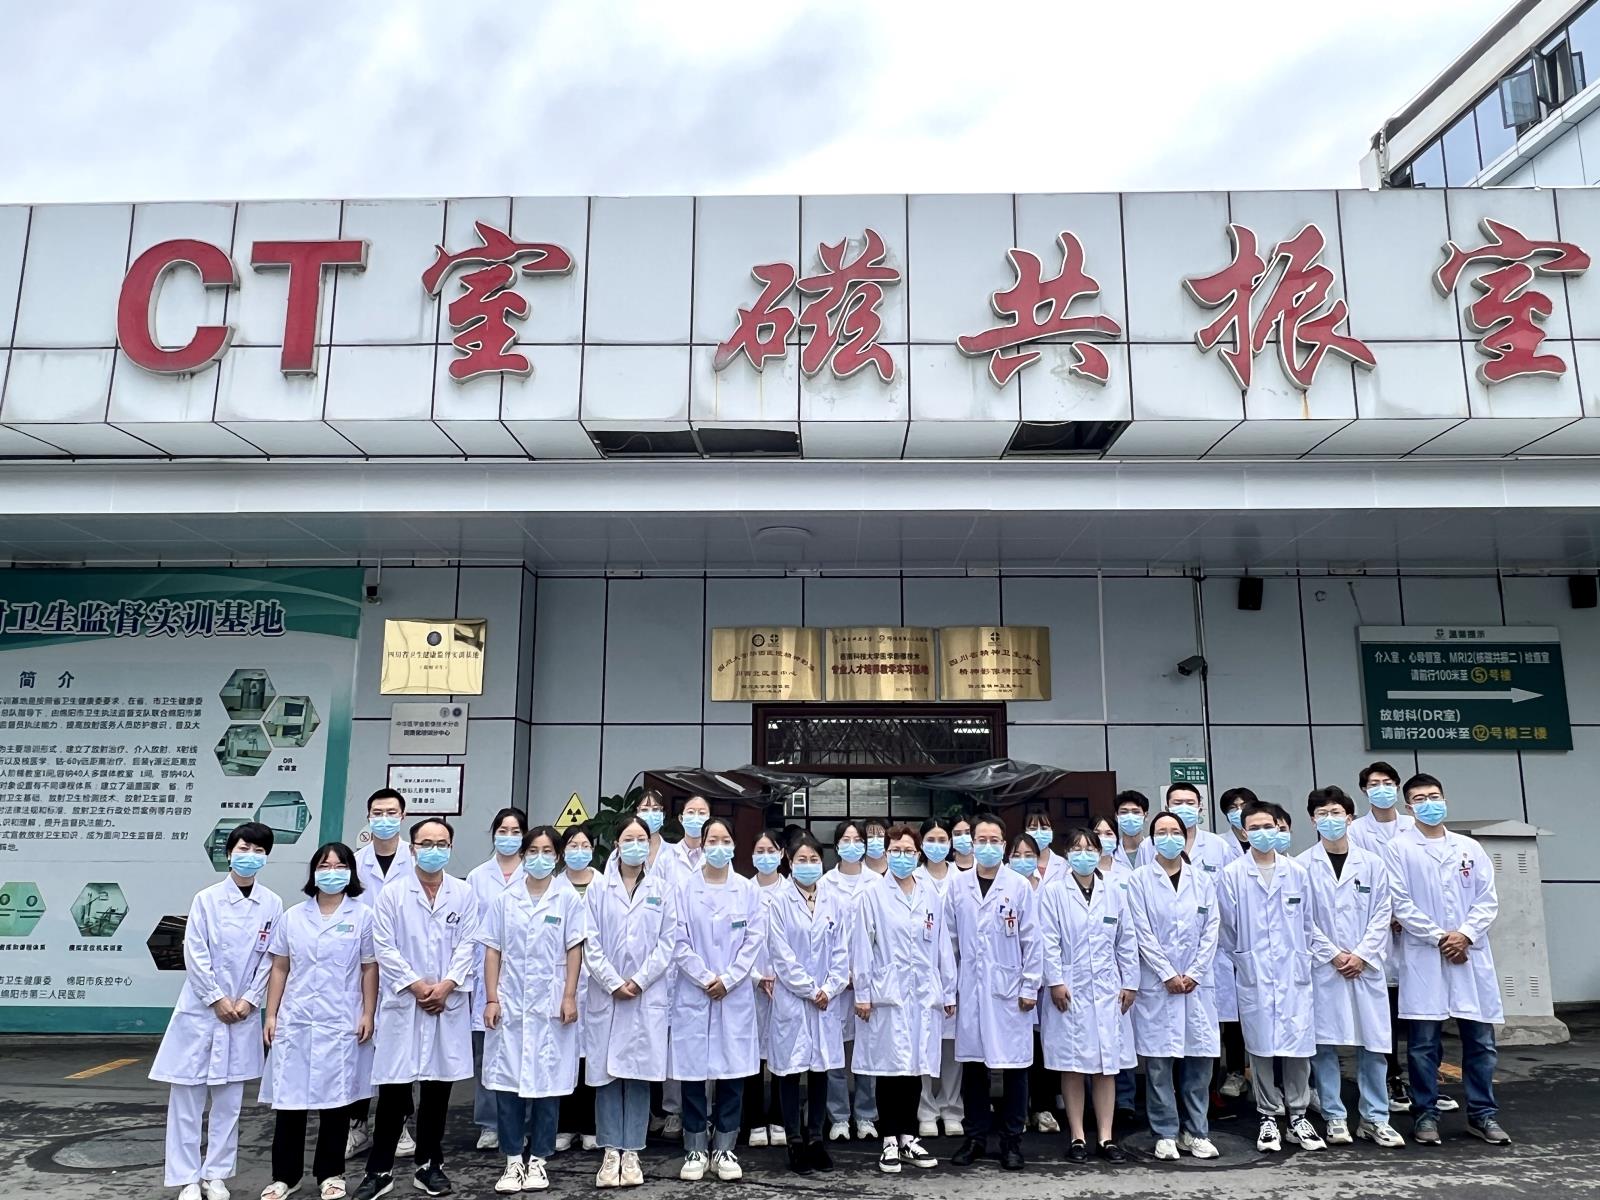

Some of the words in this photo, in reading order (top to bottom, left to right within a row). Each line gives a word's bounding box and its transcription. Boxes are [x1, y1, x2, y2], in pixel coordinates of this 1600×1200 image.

[1449, 630, 1486, 639] 温馨提示
[66, 976, 133, 987] 绵阳市疾控中心
[1, 989, 86, 1000] 绵阳市第三人民医院
